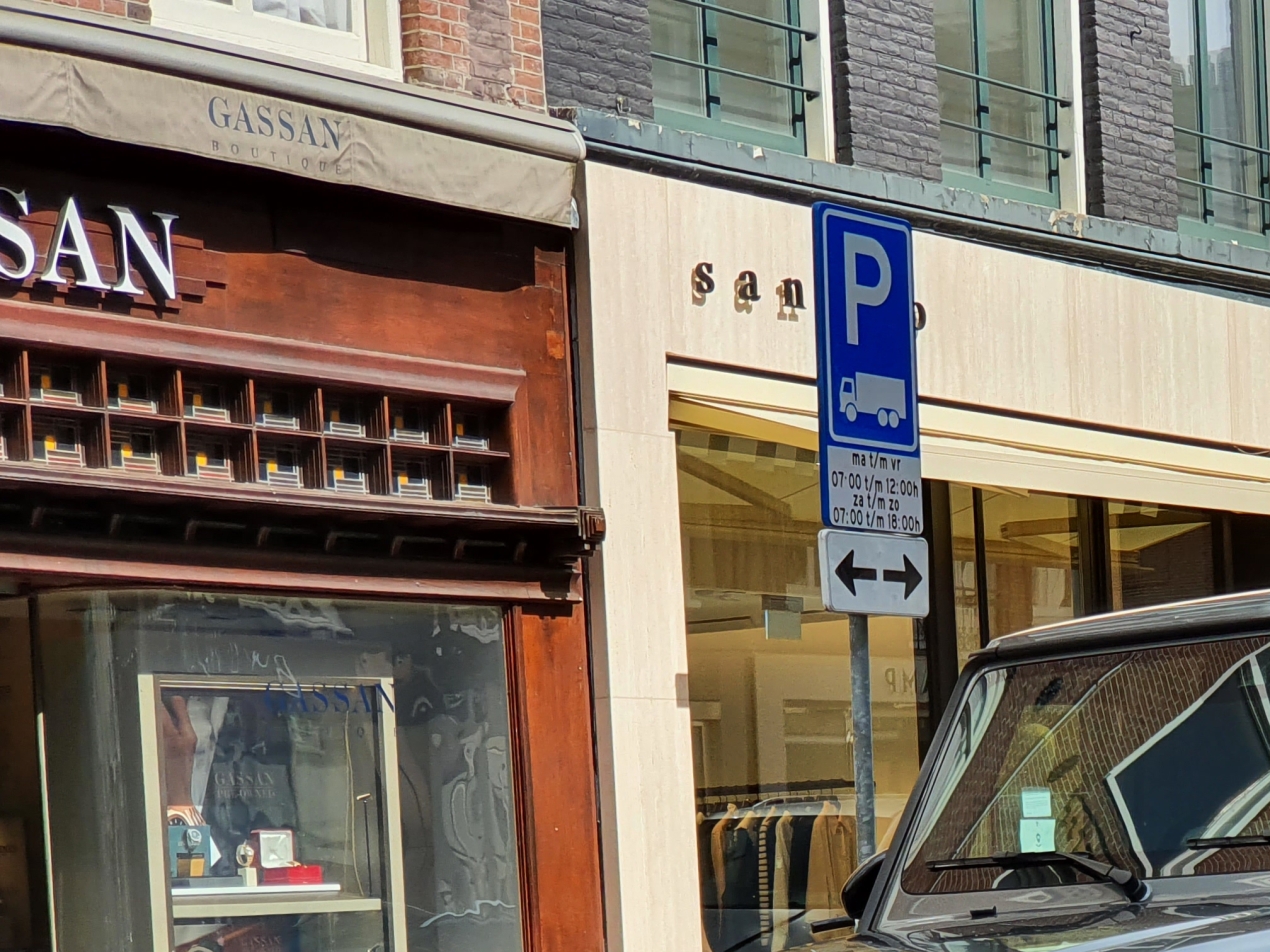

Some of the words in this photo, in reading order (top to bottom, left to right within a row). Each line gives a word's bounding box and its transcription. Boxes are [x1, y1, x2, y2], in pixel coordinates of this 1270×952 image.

[208, 96, 341, 151] GASSAN
[212, 140, 342, 174] BOUTIQUE
[843, 231, 892, 346] P
[852, 453, 866, 467] ma
[869, 452, 888, 470] t/m
[891, 458, 901, 471] vr
[864, 475, 883, 493] t/m
[886, 478, 919, 498] 12:00h
[853, 494, 864, 508] za
[867, 491, 886, 510] t/m
[888, 499, 900, 512] zo
[833, 507, 863, 526] 07:00
[866, 510, 885, 529] t/m
[888, 513, 920, 532] 18:00h
[264, 681, 395, 713] GASSAN
